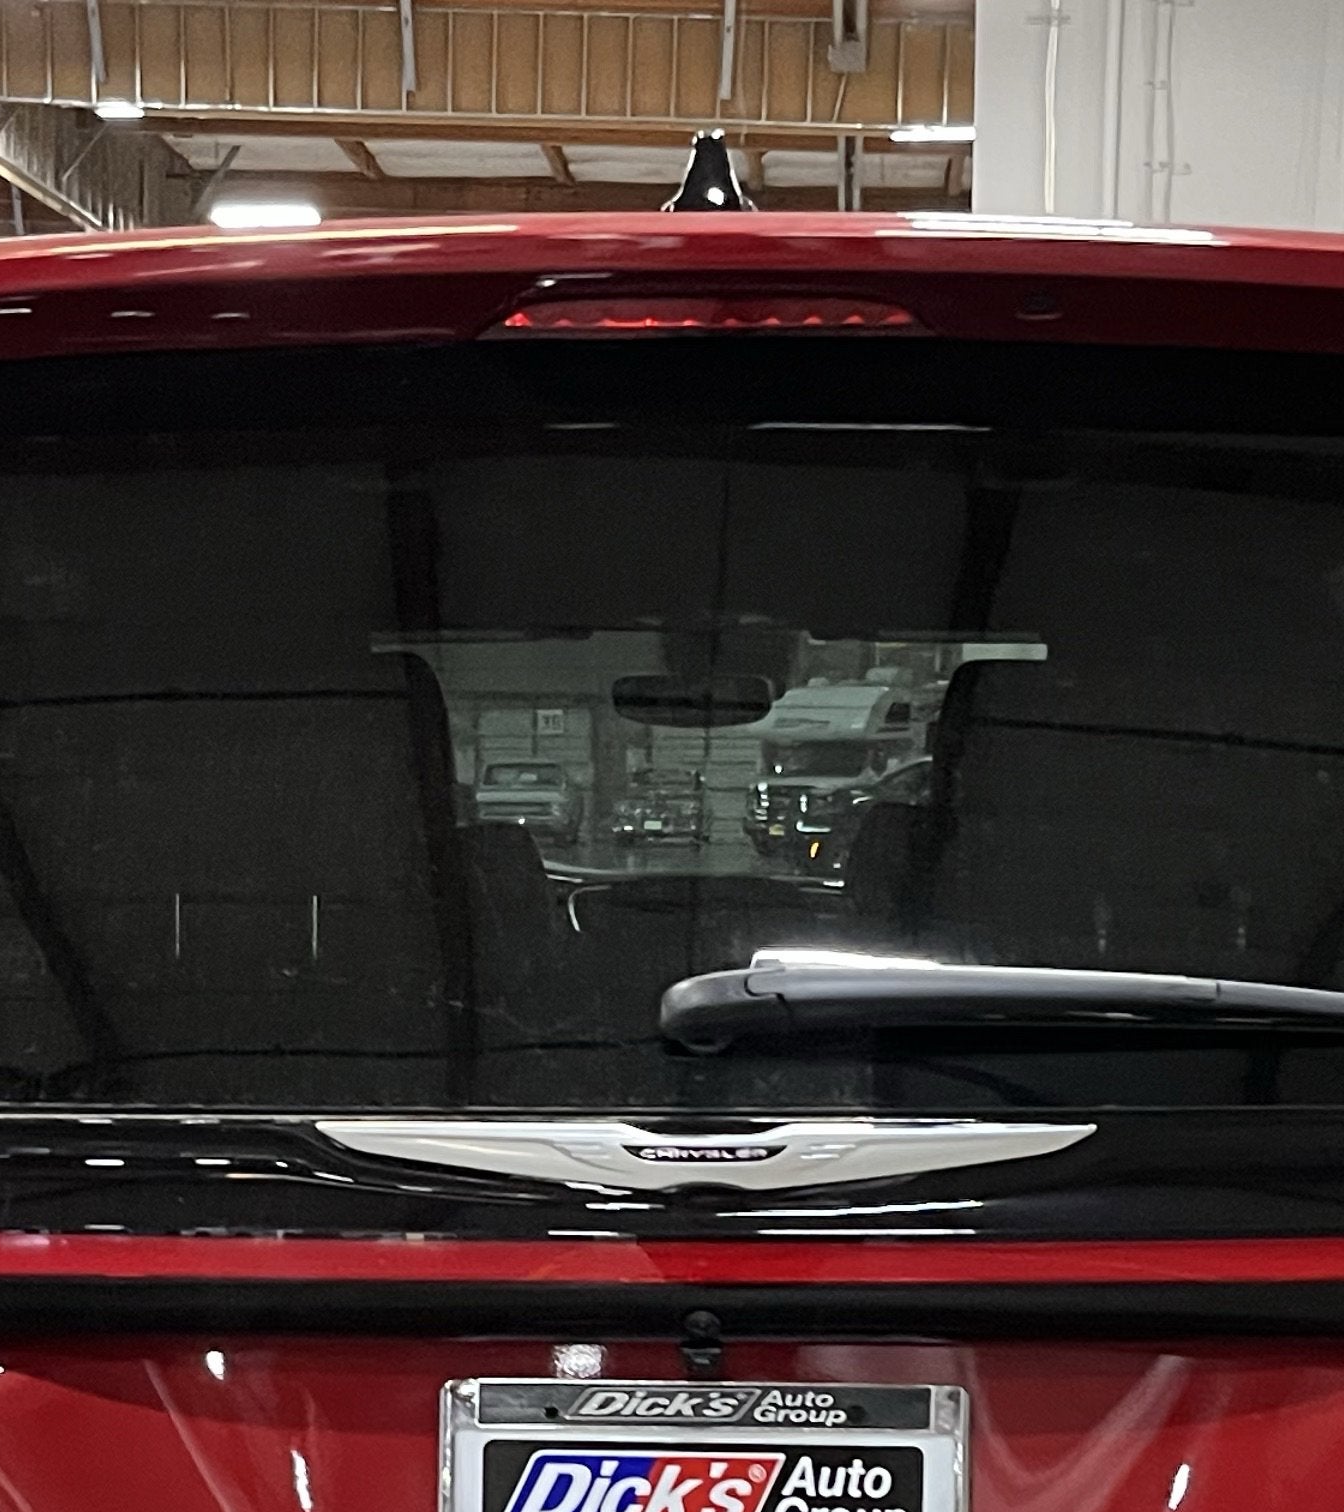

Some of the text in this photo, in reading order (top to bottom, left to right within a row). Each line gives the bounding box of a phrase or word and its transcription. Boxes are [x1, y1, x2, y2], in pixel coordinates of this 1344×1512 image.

[579, 1389, 835, 1418] Dick's Auto
[752, 1405, 848, 1427] Group
[781, 1456, 894, 1499] Auto
